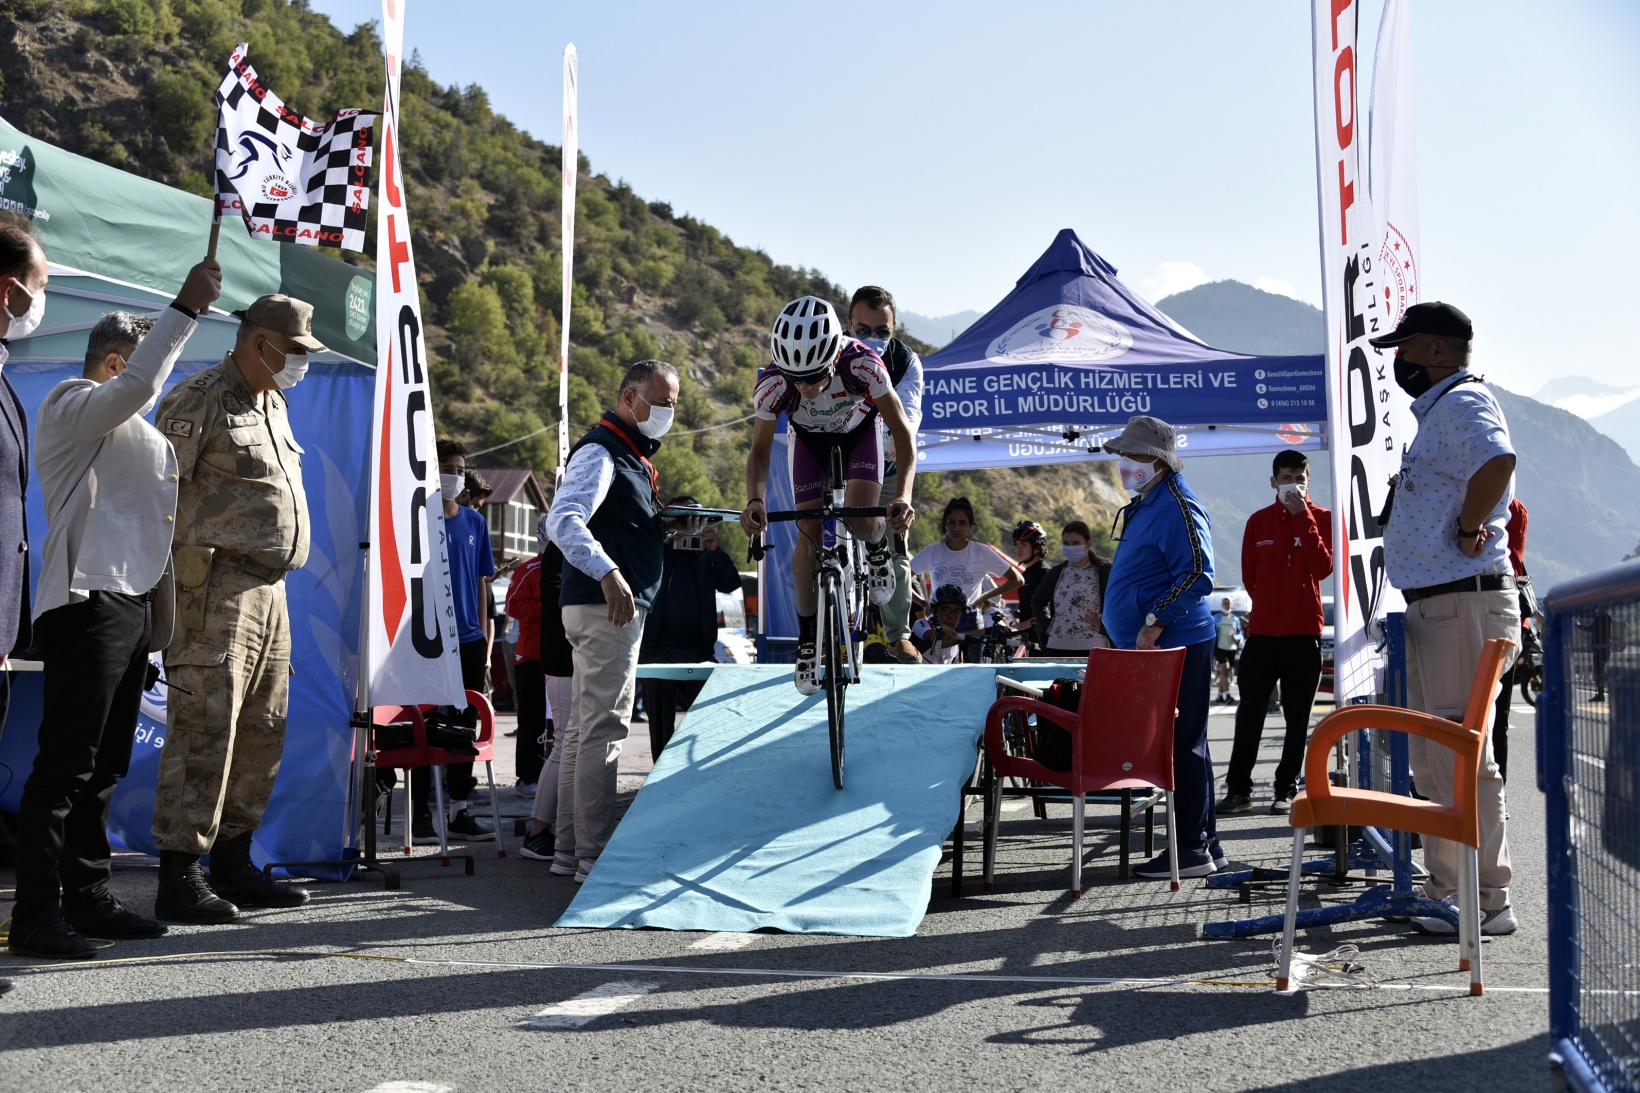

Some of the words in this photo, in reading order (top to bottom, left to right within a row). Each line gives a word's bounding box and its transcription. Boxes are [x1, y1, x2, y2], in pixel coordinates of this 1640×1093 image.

[231, 48, 267, 100] SALCANO
[352, 127, 368, 214] SALCANO
[252, 222, 344, 242] SALCANO
[922, 374, 978, 396] HANE
[982, 368, 1074, 393] GENÇLİK
[1080, 369, 1204, 390] HİZMETLERİ
[1208, 371, 1237, 389] VE
[931, 400, 990, 419] SPOR
[994, 396, 1013, 416] İL
[1018, 392, 1152, 414] MÜDÜRLÜĞÜ
